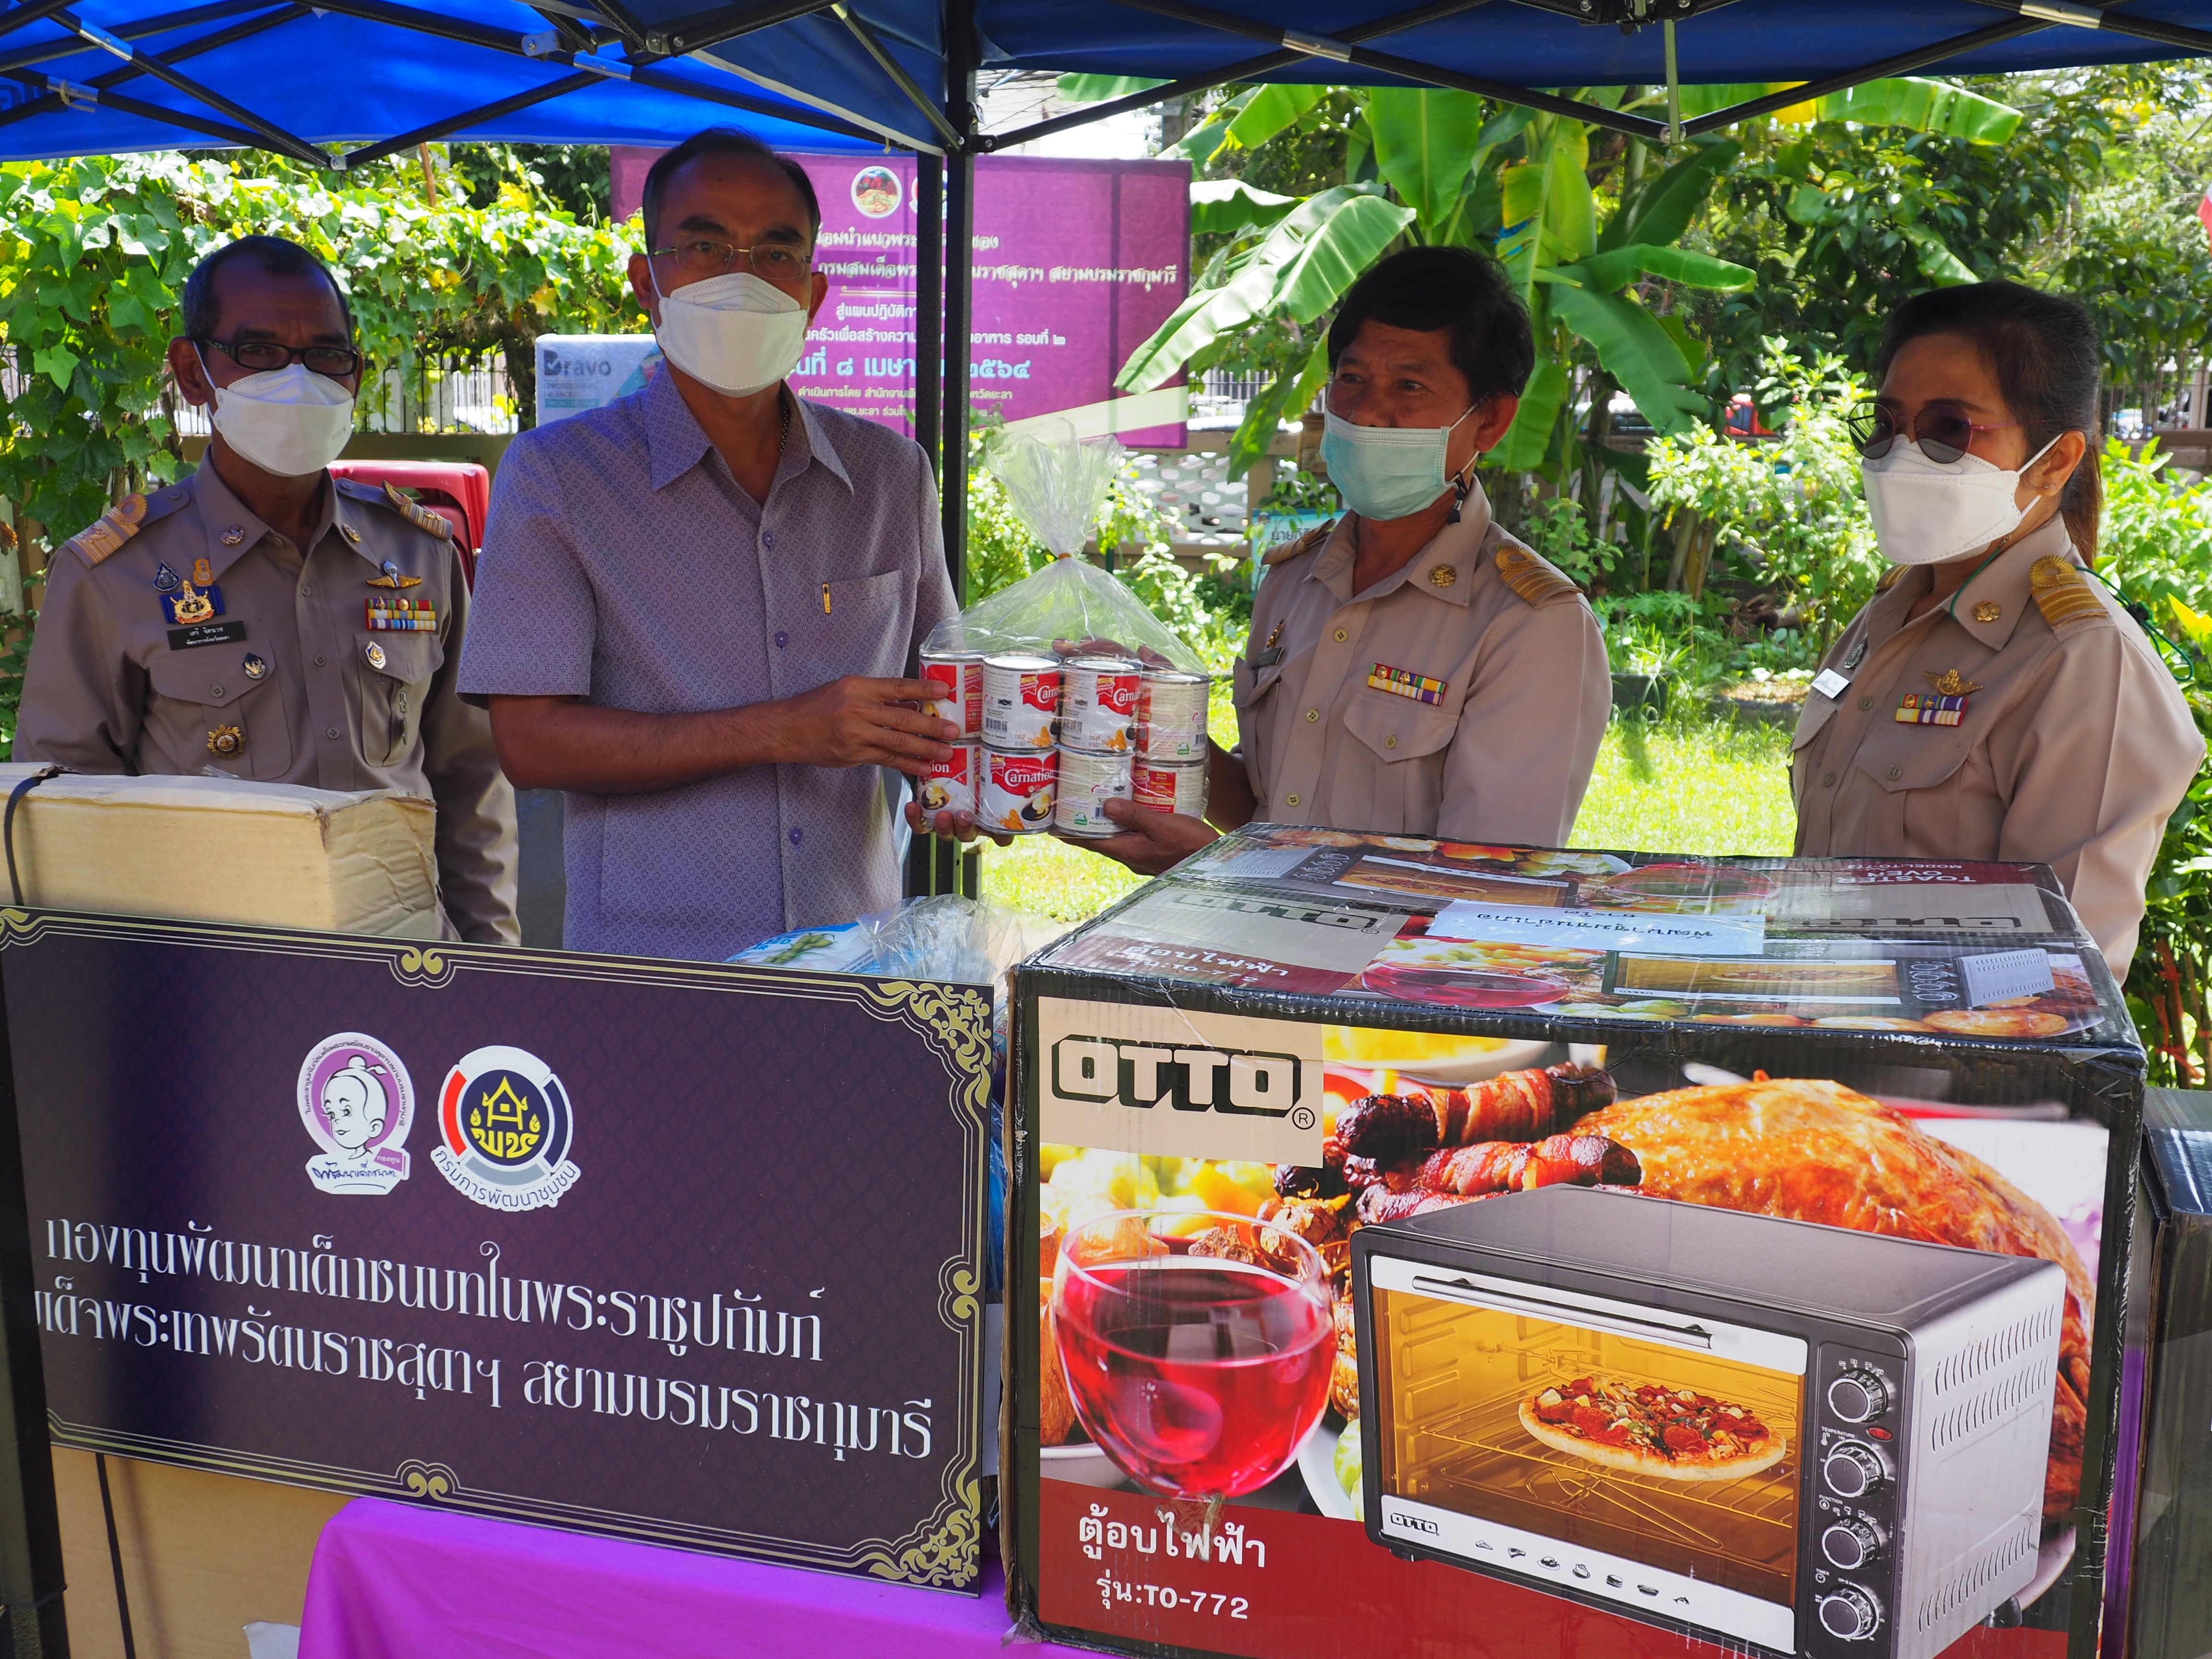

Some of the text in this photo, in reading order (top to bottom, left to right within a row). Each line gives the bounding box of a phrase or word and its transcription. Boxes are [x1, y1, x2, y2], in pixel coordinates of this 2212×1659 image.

[1016, 328, 1049, 344] รอบที่
[543, 349, 612, 376] Bravo
[1004, 769, 1054, 787] Carnation
[1172, 894, 1378, 930] OTTO
[1051, 1034, 1301, 1118] OTTO
[376, 1155, 400, 1164] กองทุน
[434, 1150, 576, 1208] กรมการพัฒนาชุมชน
[46, 1218, 825, 1362] กองทุนพัฒนาเด็กชนบทในพระราชูปถัมภ์
[523, 1359, 932, 1462] สยามบรมราชกุมารี
[1821, 1426, 1855, 1439] TEMPERATURE
[1819, 1494, 1843, 1505] FUNCTION
[1079, 1503, 1266, 1568] ตู้อบไฟฟ้า
[1390, 1513, 1438, 1534] OTTO
[1096, 1569, 1249, 1620] รุ่น:TO-772
